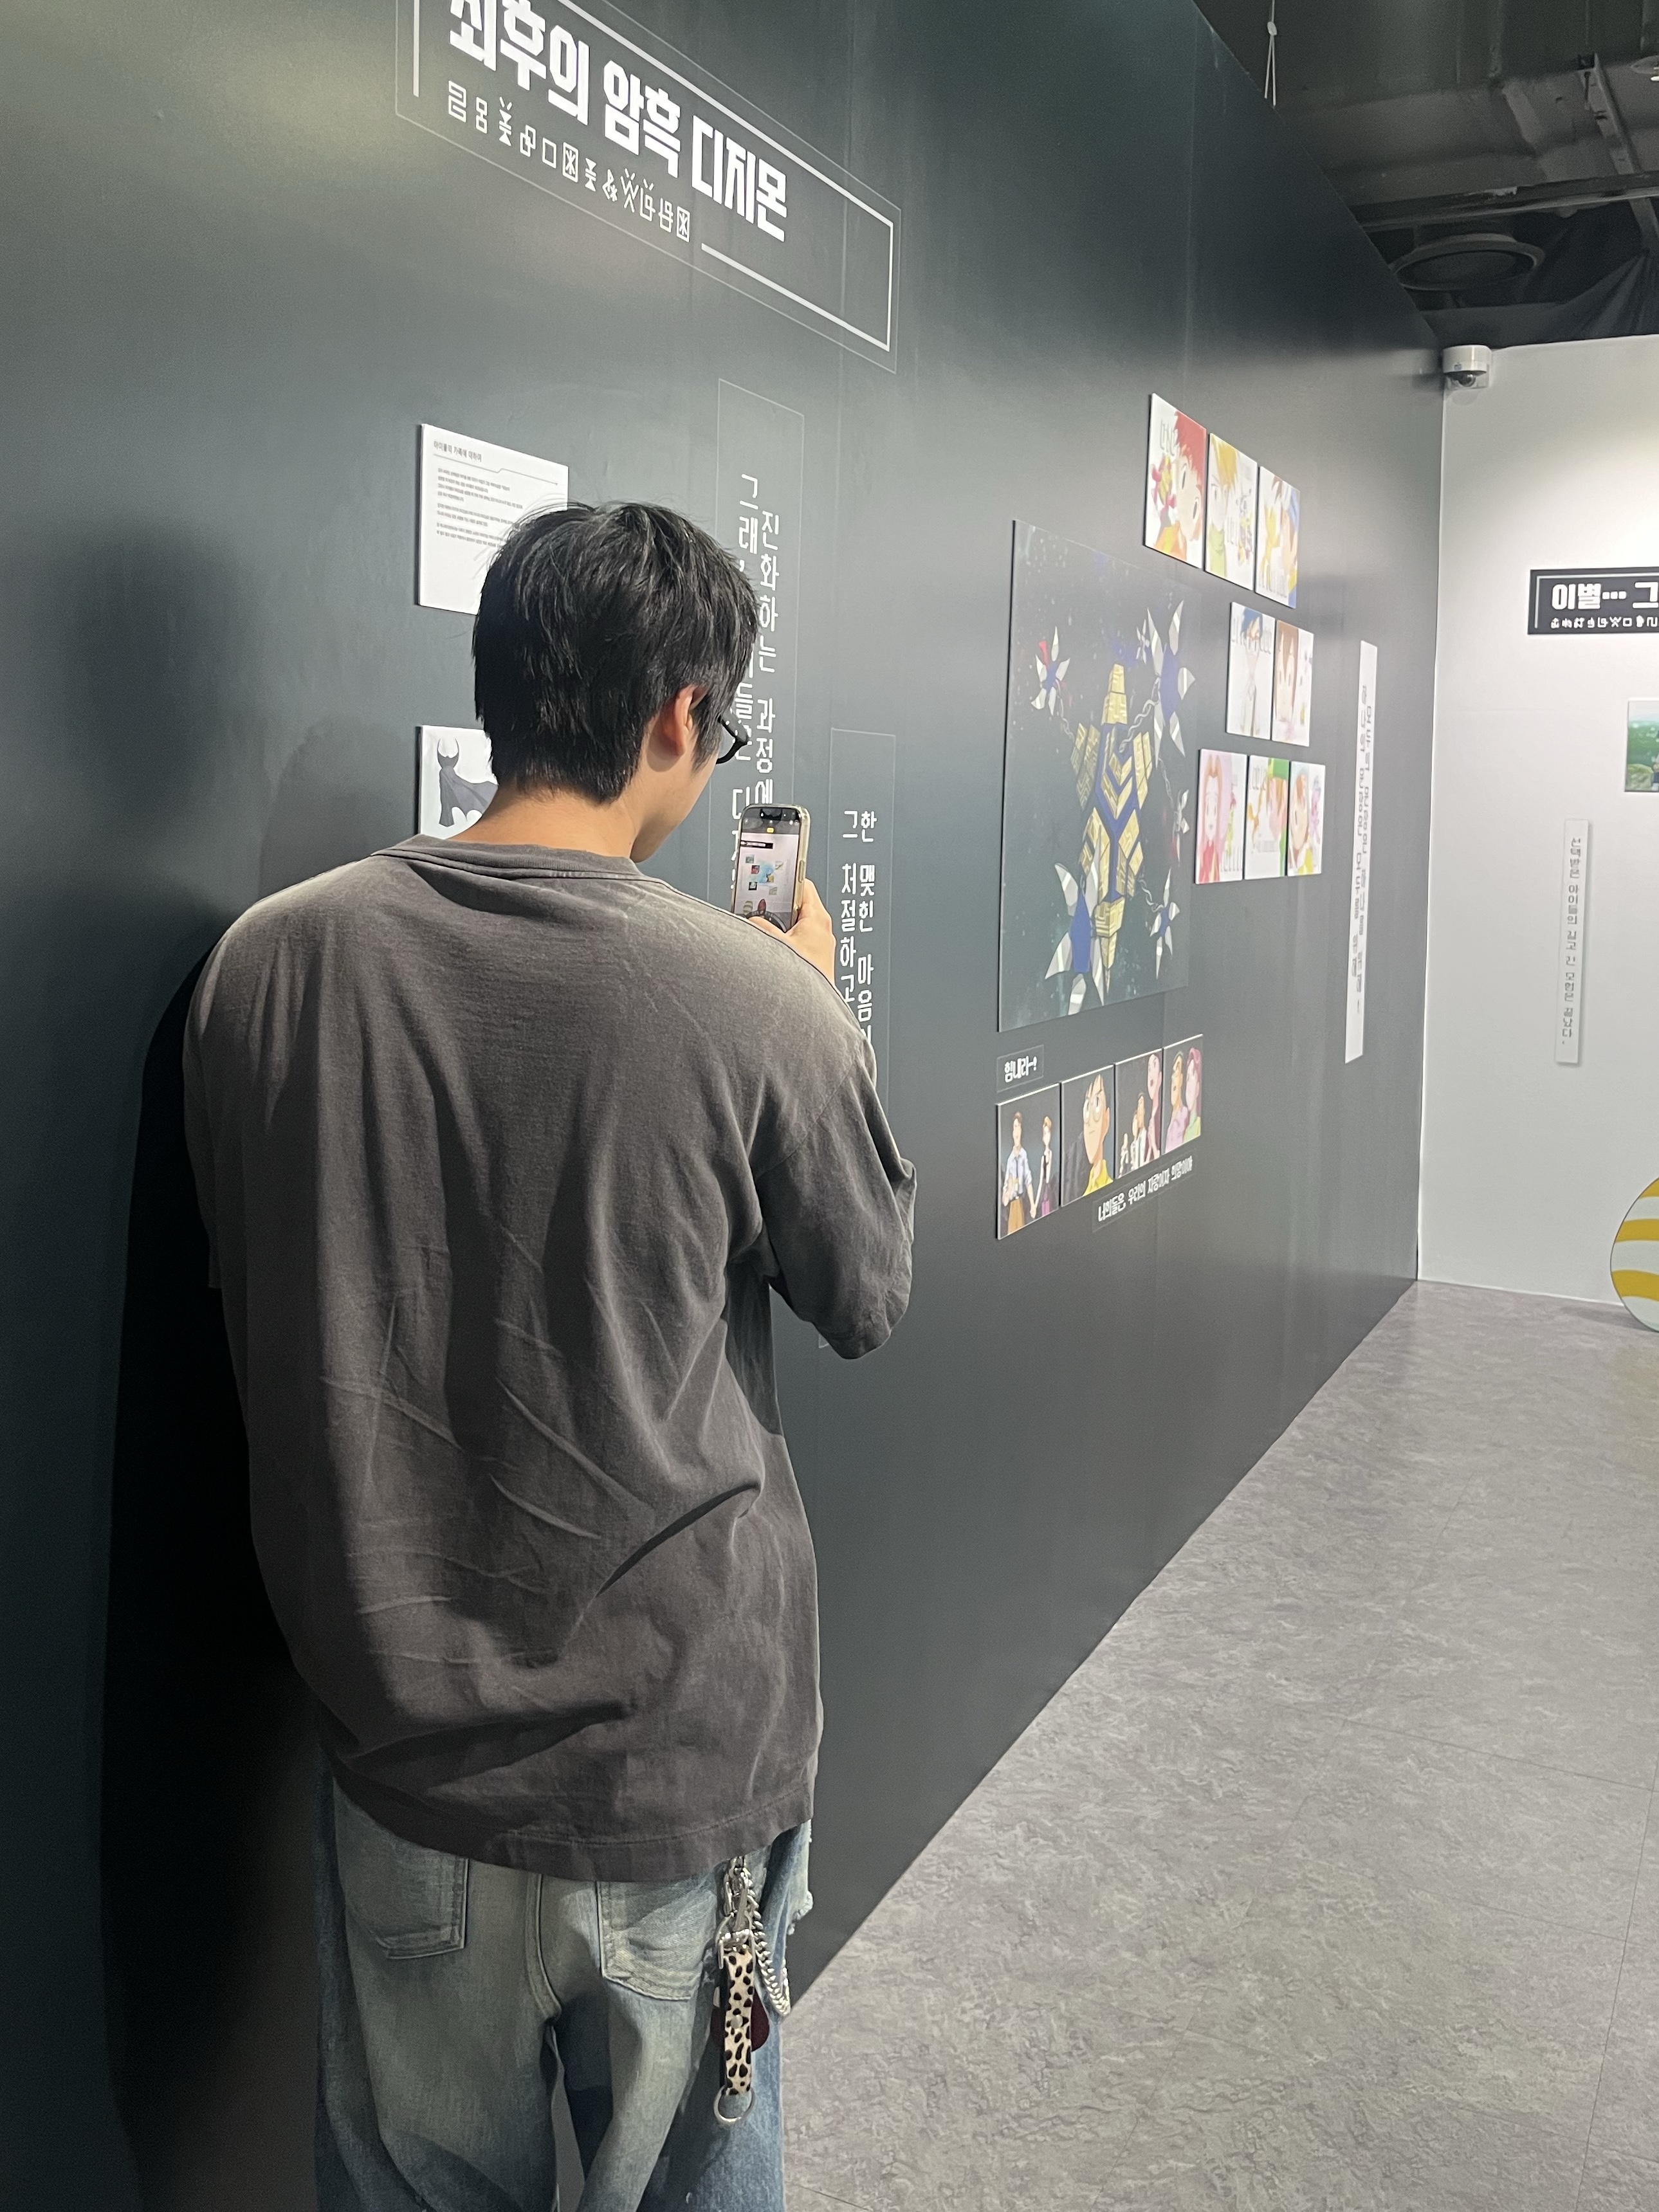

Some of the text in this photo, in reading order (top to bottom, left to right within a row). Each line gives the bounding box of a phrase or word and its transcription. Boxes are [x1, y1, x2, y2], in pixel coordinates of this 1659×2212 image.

[603, 60, 681, 179] 암흑
[691, 114, 788, 242] 디지몬
[738, 473, 759, 572] 그래,
[758, 511, 780, 673] 진화하는
[839, 810, 859, 1003] 그 처절하고
[1567, 884, 1579, 925] 아이들의
[1564, 972, 1575, 1002] 모험은
[1566, 956, 1576, 967] 긴
[1098, 1192, 1126, 1222] 너희들은
